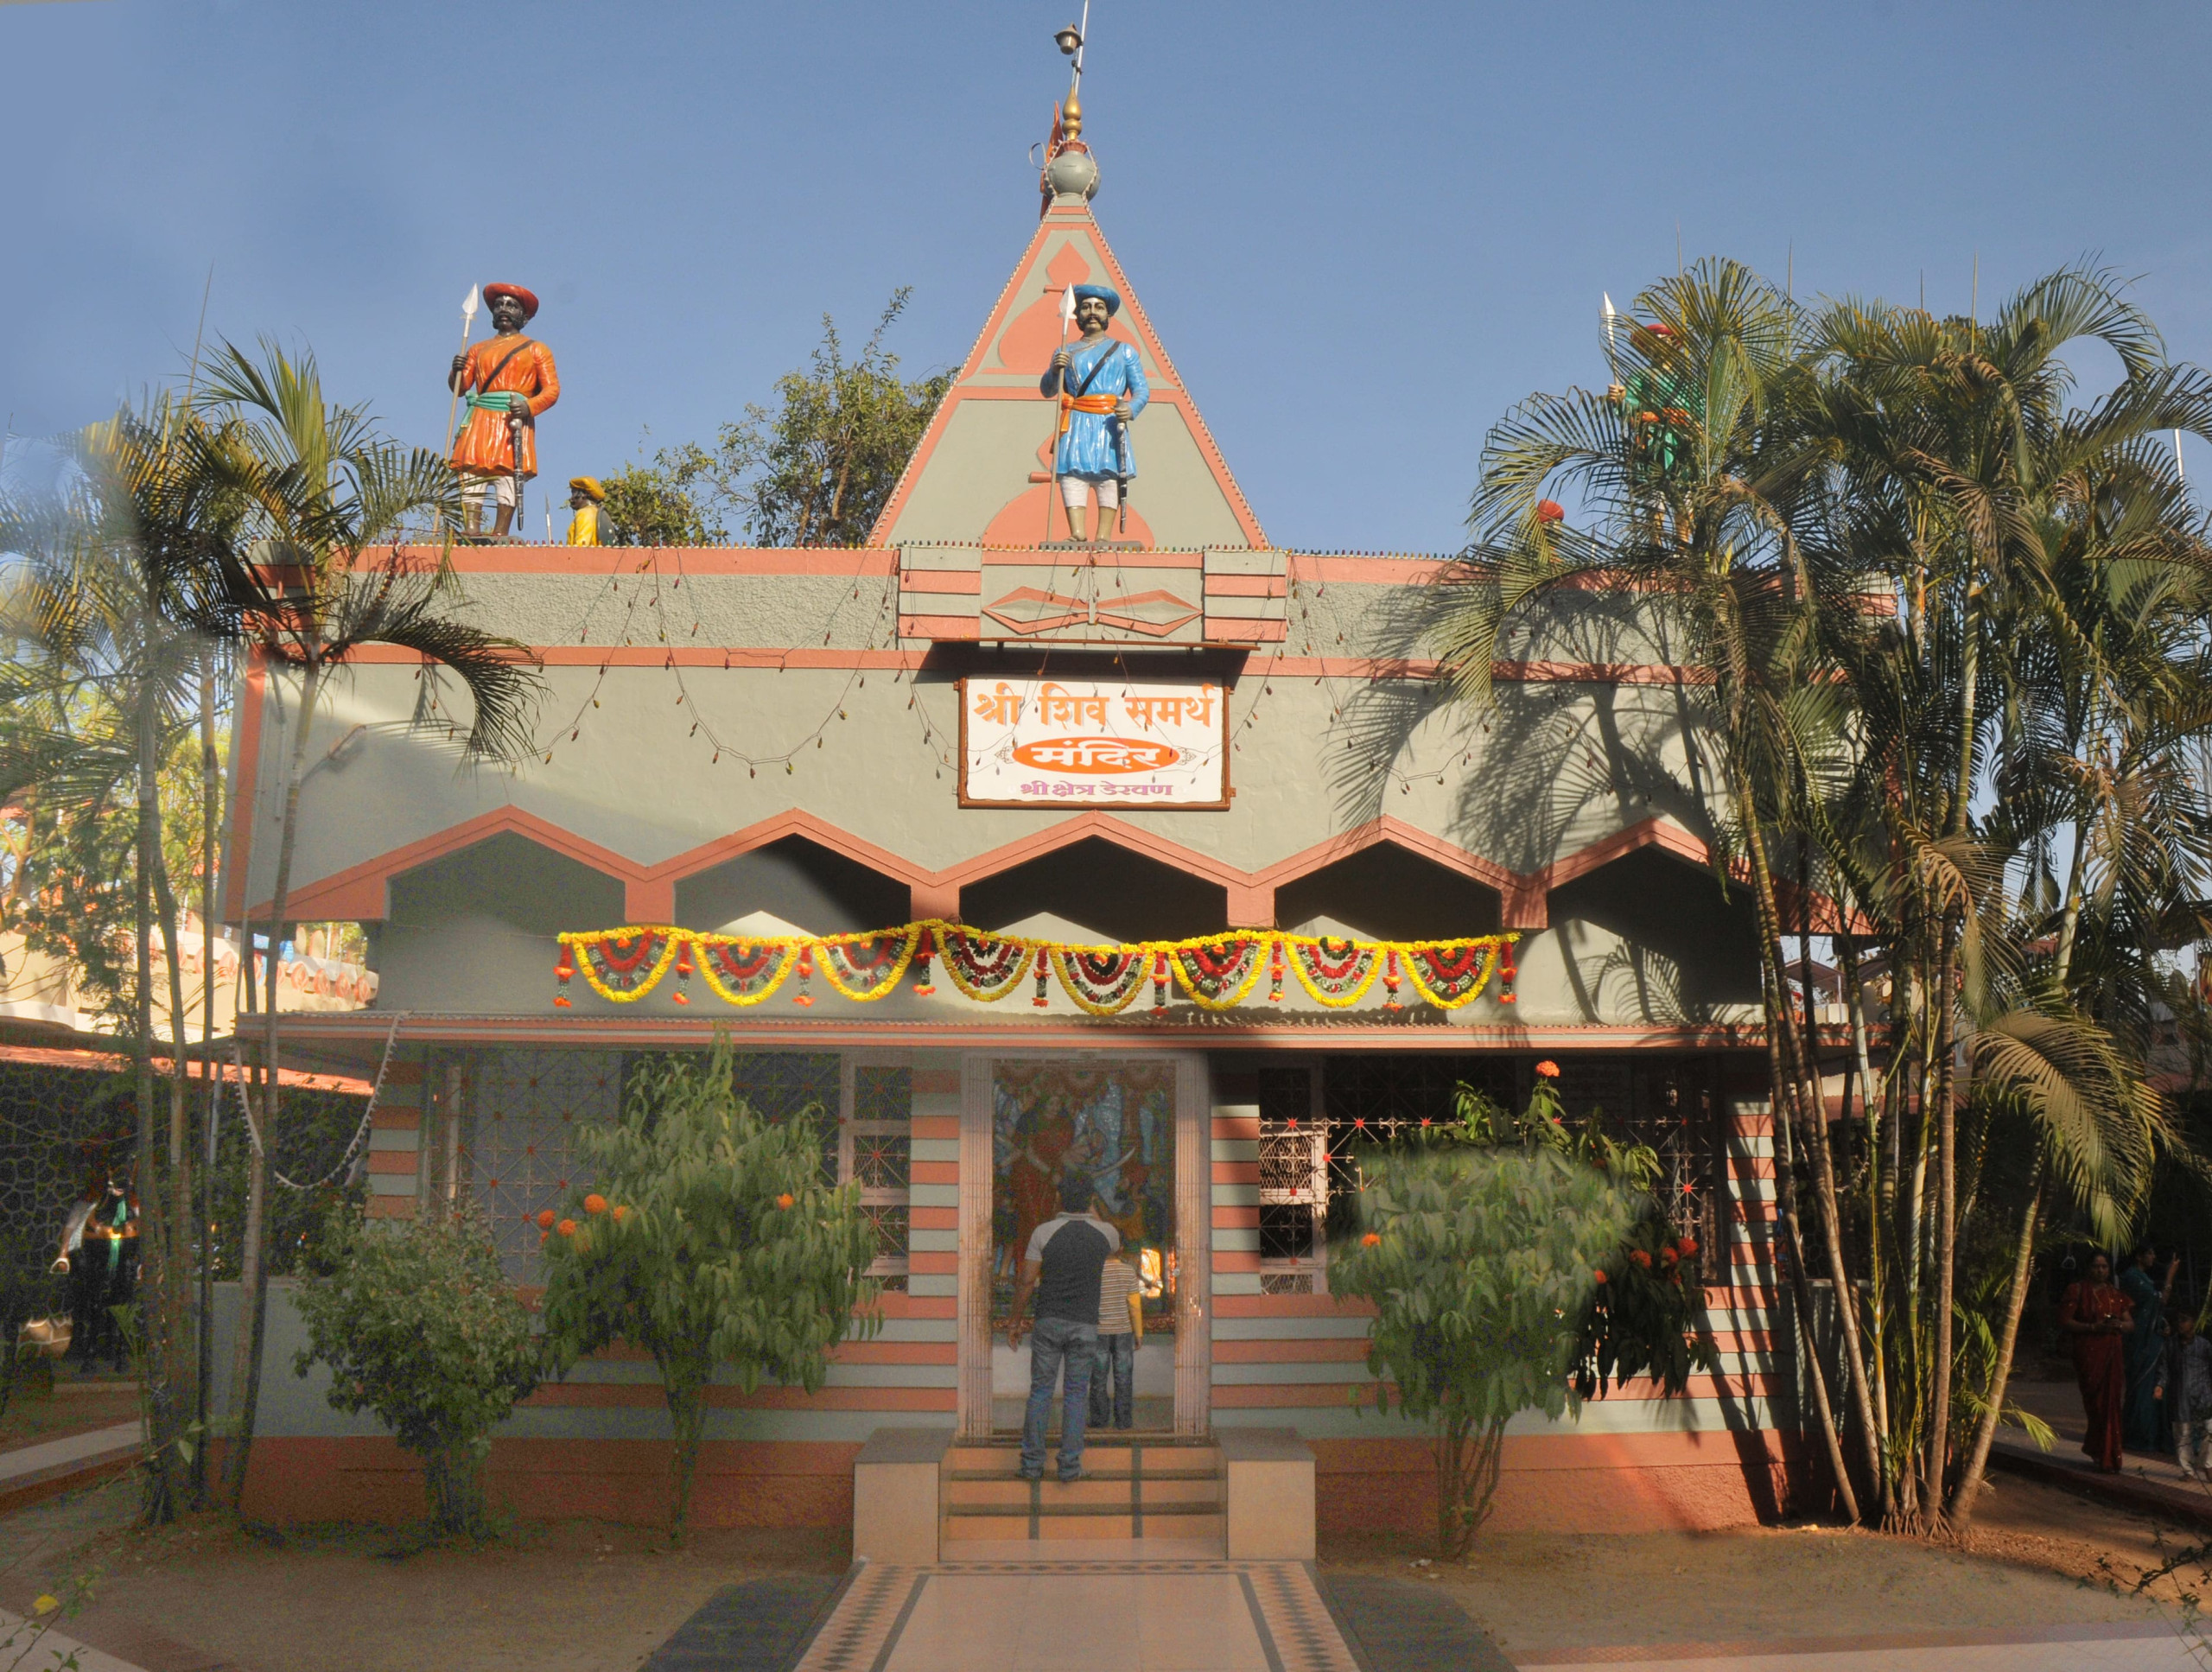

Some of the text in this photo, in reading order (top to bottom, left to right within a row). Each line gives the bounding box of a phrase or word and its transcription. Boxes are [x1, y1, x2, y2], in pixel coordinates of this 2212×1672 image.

[973, 682, 1217, 730] श्री शिव समर्थ
[1031, 740, 1160, 768] मंदिर
[1020, 780, 1174, 797] श्री क्षेत्र डेरवण
